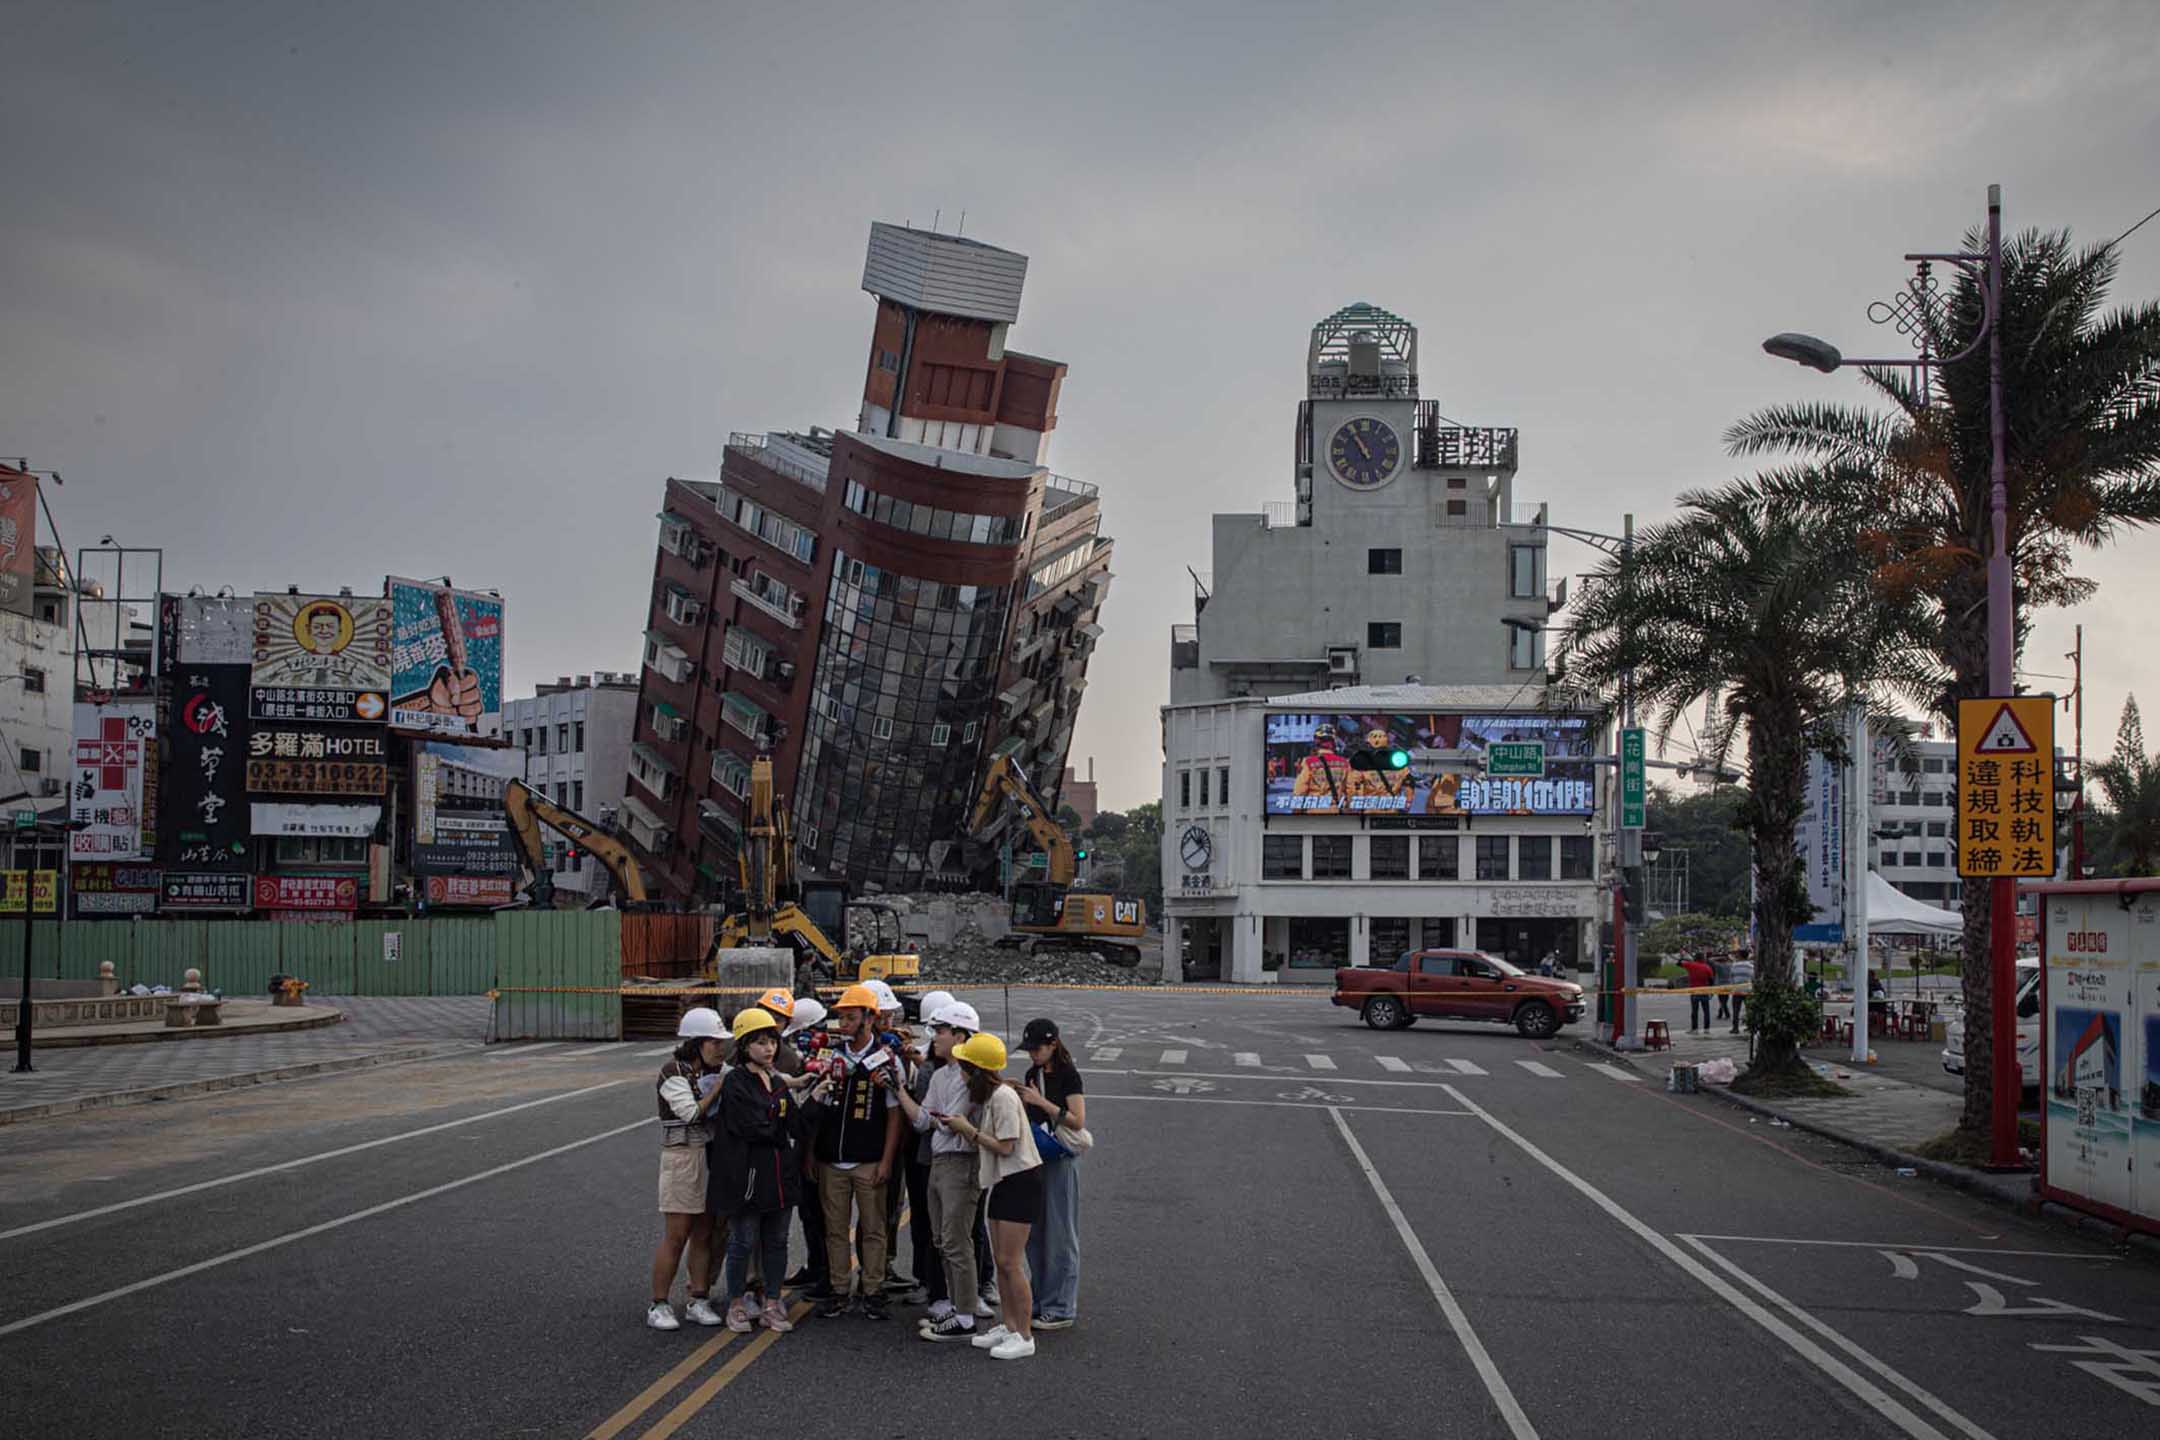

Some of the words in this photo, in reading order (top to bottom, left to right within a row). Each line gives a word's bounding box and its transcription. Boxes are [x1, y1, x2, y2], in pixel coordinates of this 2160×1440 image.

[249, 732, 325, 758] 多羅滿
[326, 738, 385, 756] HOTEL
[1495, 746, 1537, 760] 中山路
[1967, 760, 2001, 873] 違規取締
[2010, 759, 2046, 872] 科技執法
[1115, 901, 1138, 924] CAT
